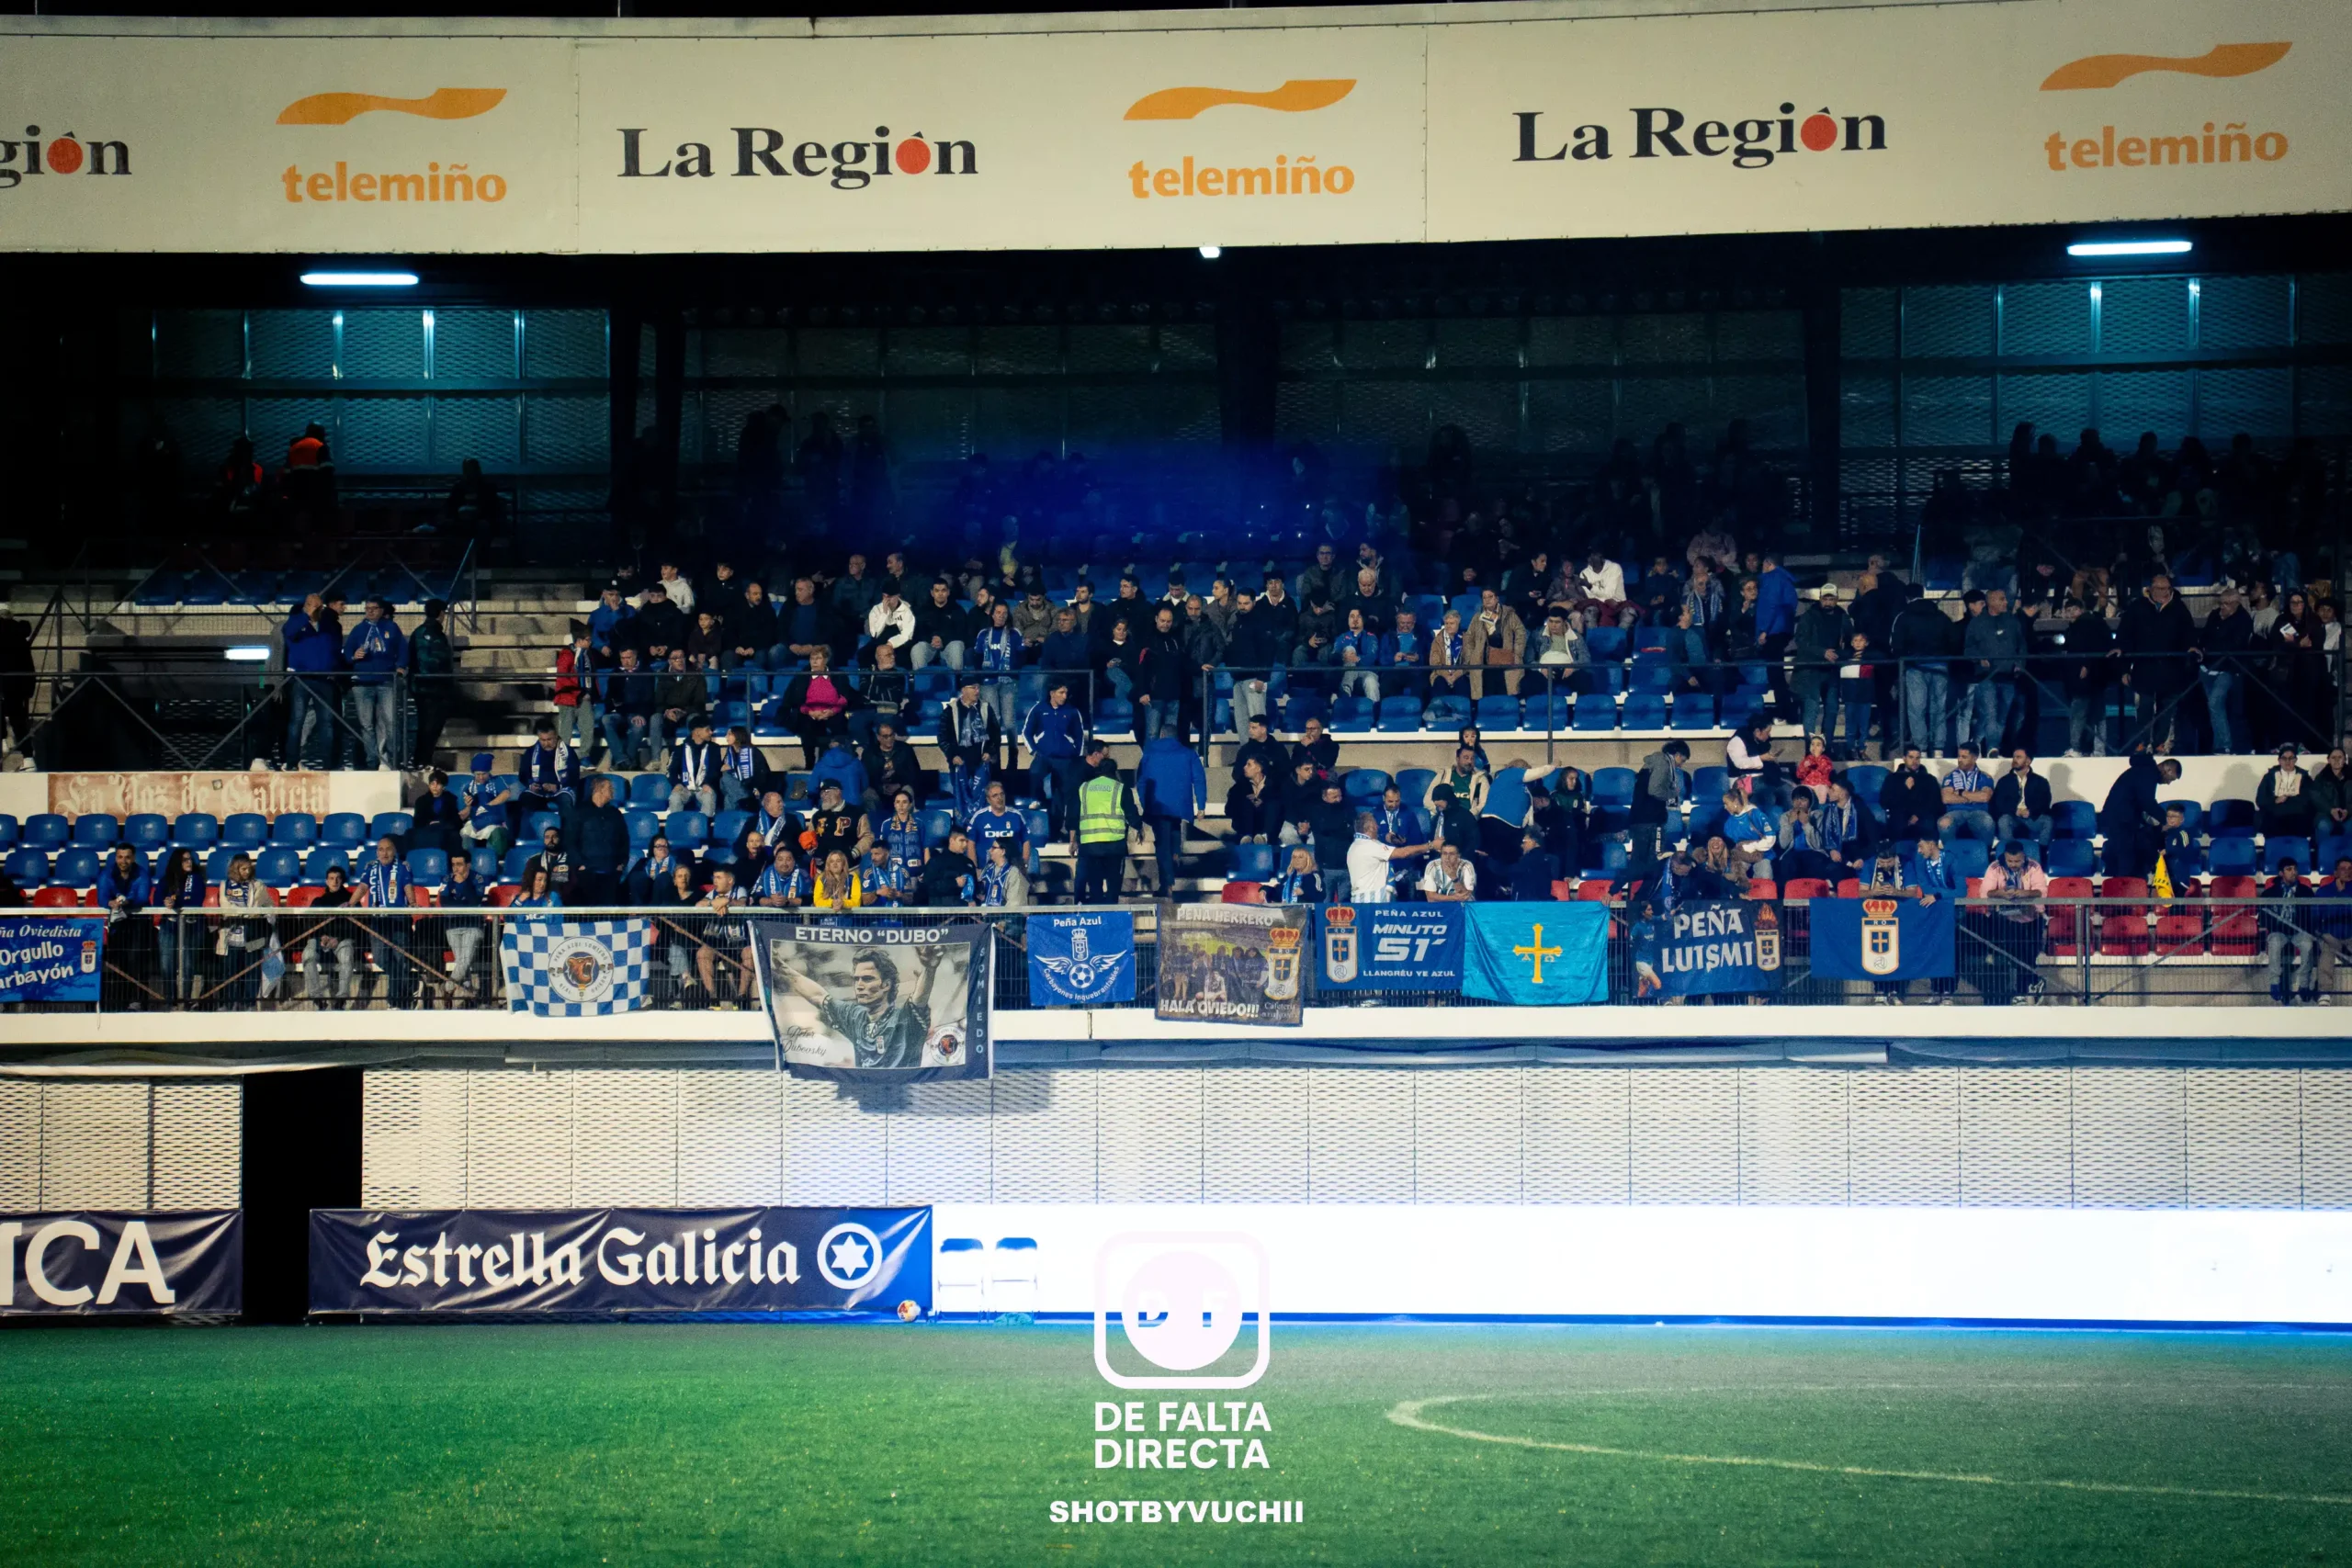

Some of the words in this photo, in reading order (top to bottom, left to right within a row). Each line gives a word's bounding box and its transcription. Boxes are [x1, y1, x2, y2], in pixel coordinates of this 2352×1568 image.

[1512, 111, 1613, 163] La
[1629, 102, 1888, 169] Región
[2044, 121, 2289, 172] telemiño
[616, 128, 716, 178] La
[730, 125, 978, 190] Región
[282, 161, 507, 203] telemiño
[1128, 154, 1356, 199] telemiño
[181, 773, 209, 815] de
[984, 830, 1014, 839] DIGI
[1053, 918, 1077, 928] Peña
[1080, 917, 1102, 927] Azul
[1215, 909, 1274, 927] HERRERO
[1372, 924, 1448, 935] MINUTO
[1374, 908, 1408, 918] PEÑA
[1673, 903, 1744, 940] PEÑA
[19, 924, 82, 938] Oviedista
[795, 926, 873, 943] ETERNO
[0, 941, 64, 966] Orgullo
[1661, 941, 1754, 974] LUISMI
[1044, 967, 1074, 1000] Carbayones
[1074, 965, 1120, 1002] Inquebrantables
[359, 1230, 585, 1288] Estrella
[597, 1227, 802, 1287] Galicia
